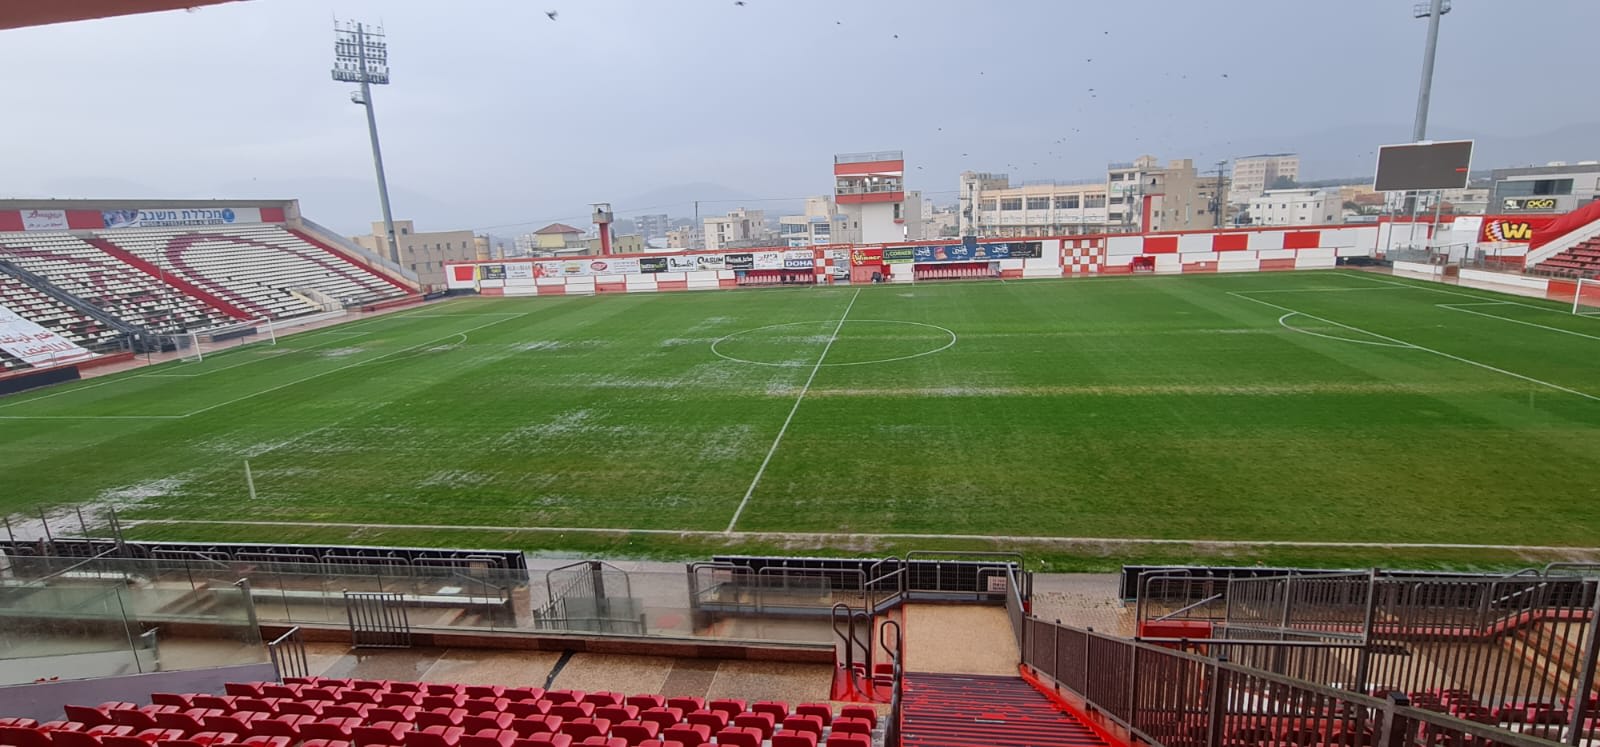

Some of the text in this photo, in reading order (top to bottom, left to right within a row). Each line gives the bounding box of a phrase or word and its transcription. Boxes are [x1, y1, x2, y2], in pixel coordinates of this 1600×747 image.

[140, 209, 222, 221] מכללת משגב
[855, 253, 881, 261] Winner
[785, 260, 814, 268] DOHA
